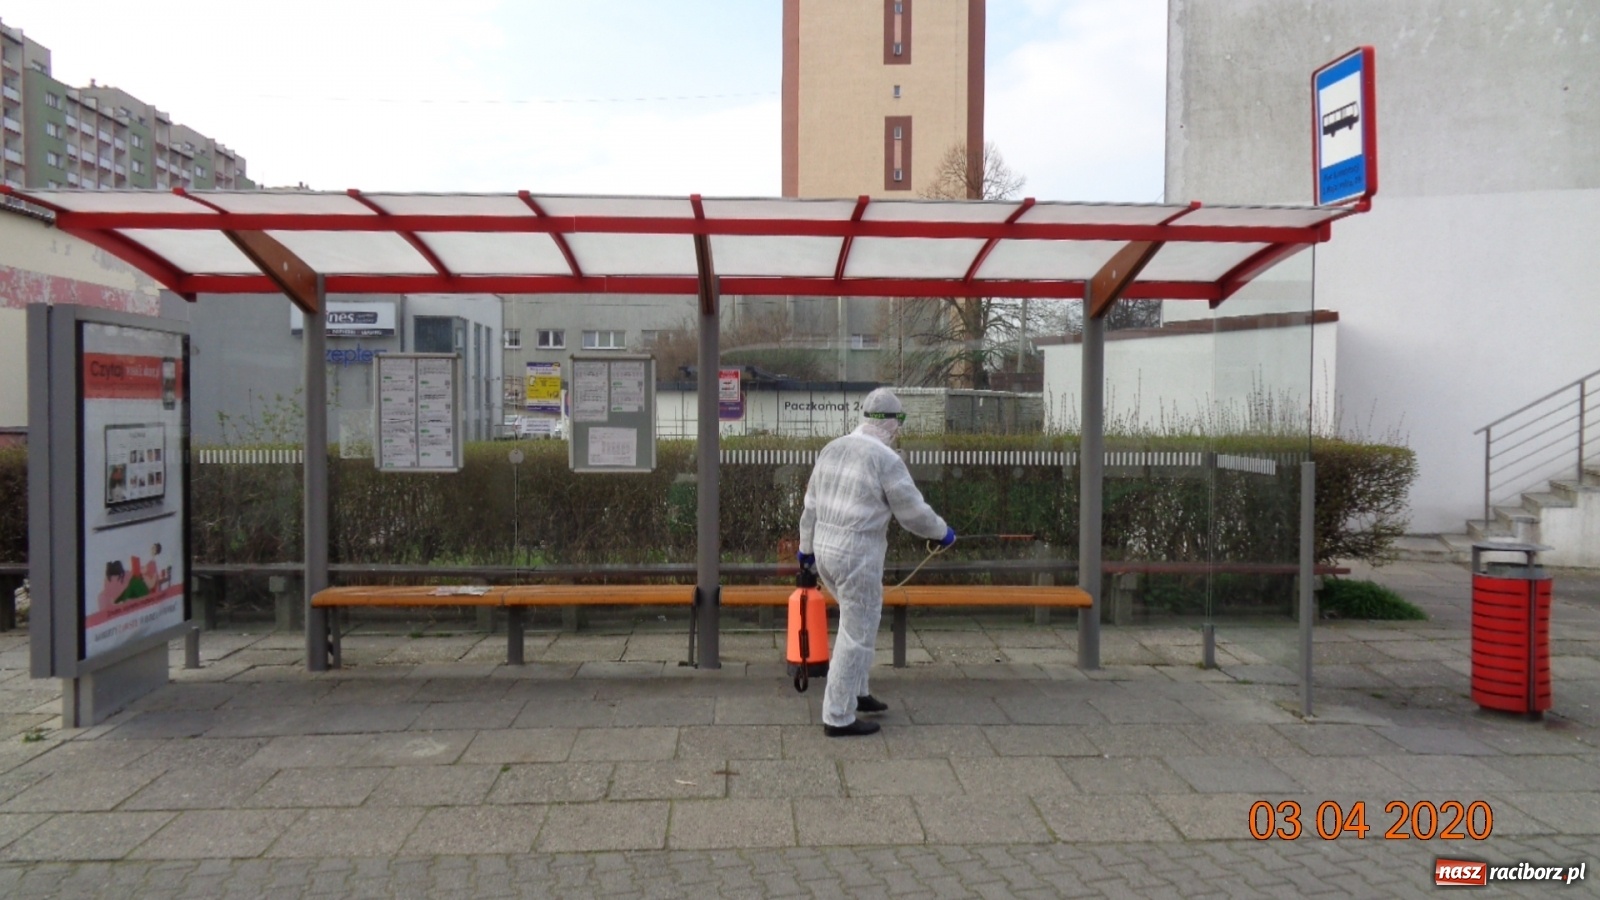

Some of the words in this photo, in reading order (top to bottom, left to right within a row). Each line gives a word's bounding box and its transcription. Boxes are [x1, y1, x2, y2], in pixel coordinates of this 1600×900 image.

[326, 312, 355, 323] nes
[90, 360, 125, 381] Czytaj
[784, 401, 850, 412] Paczkomat
